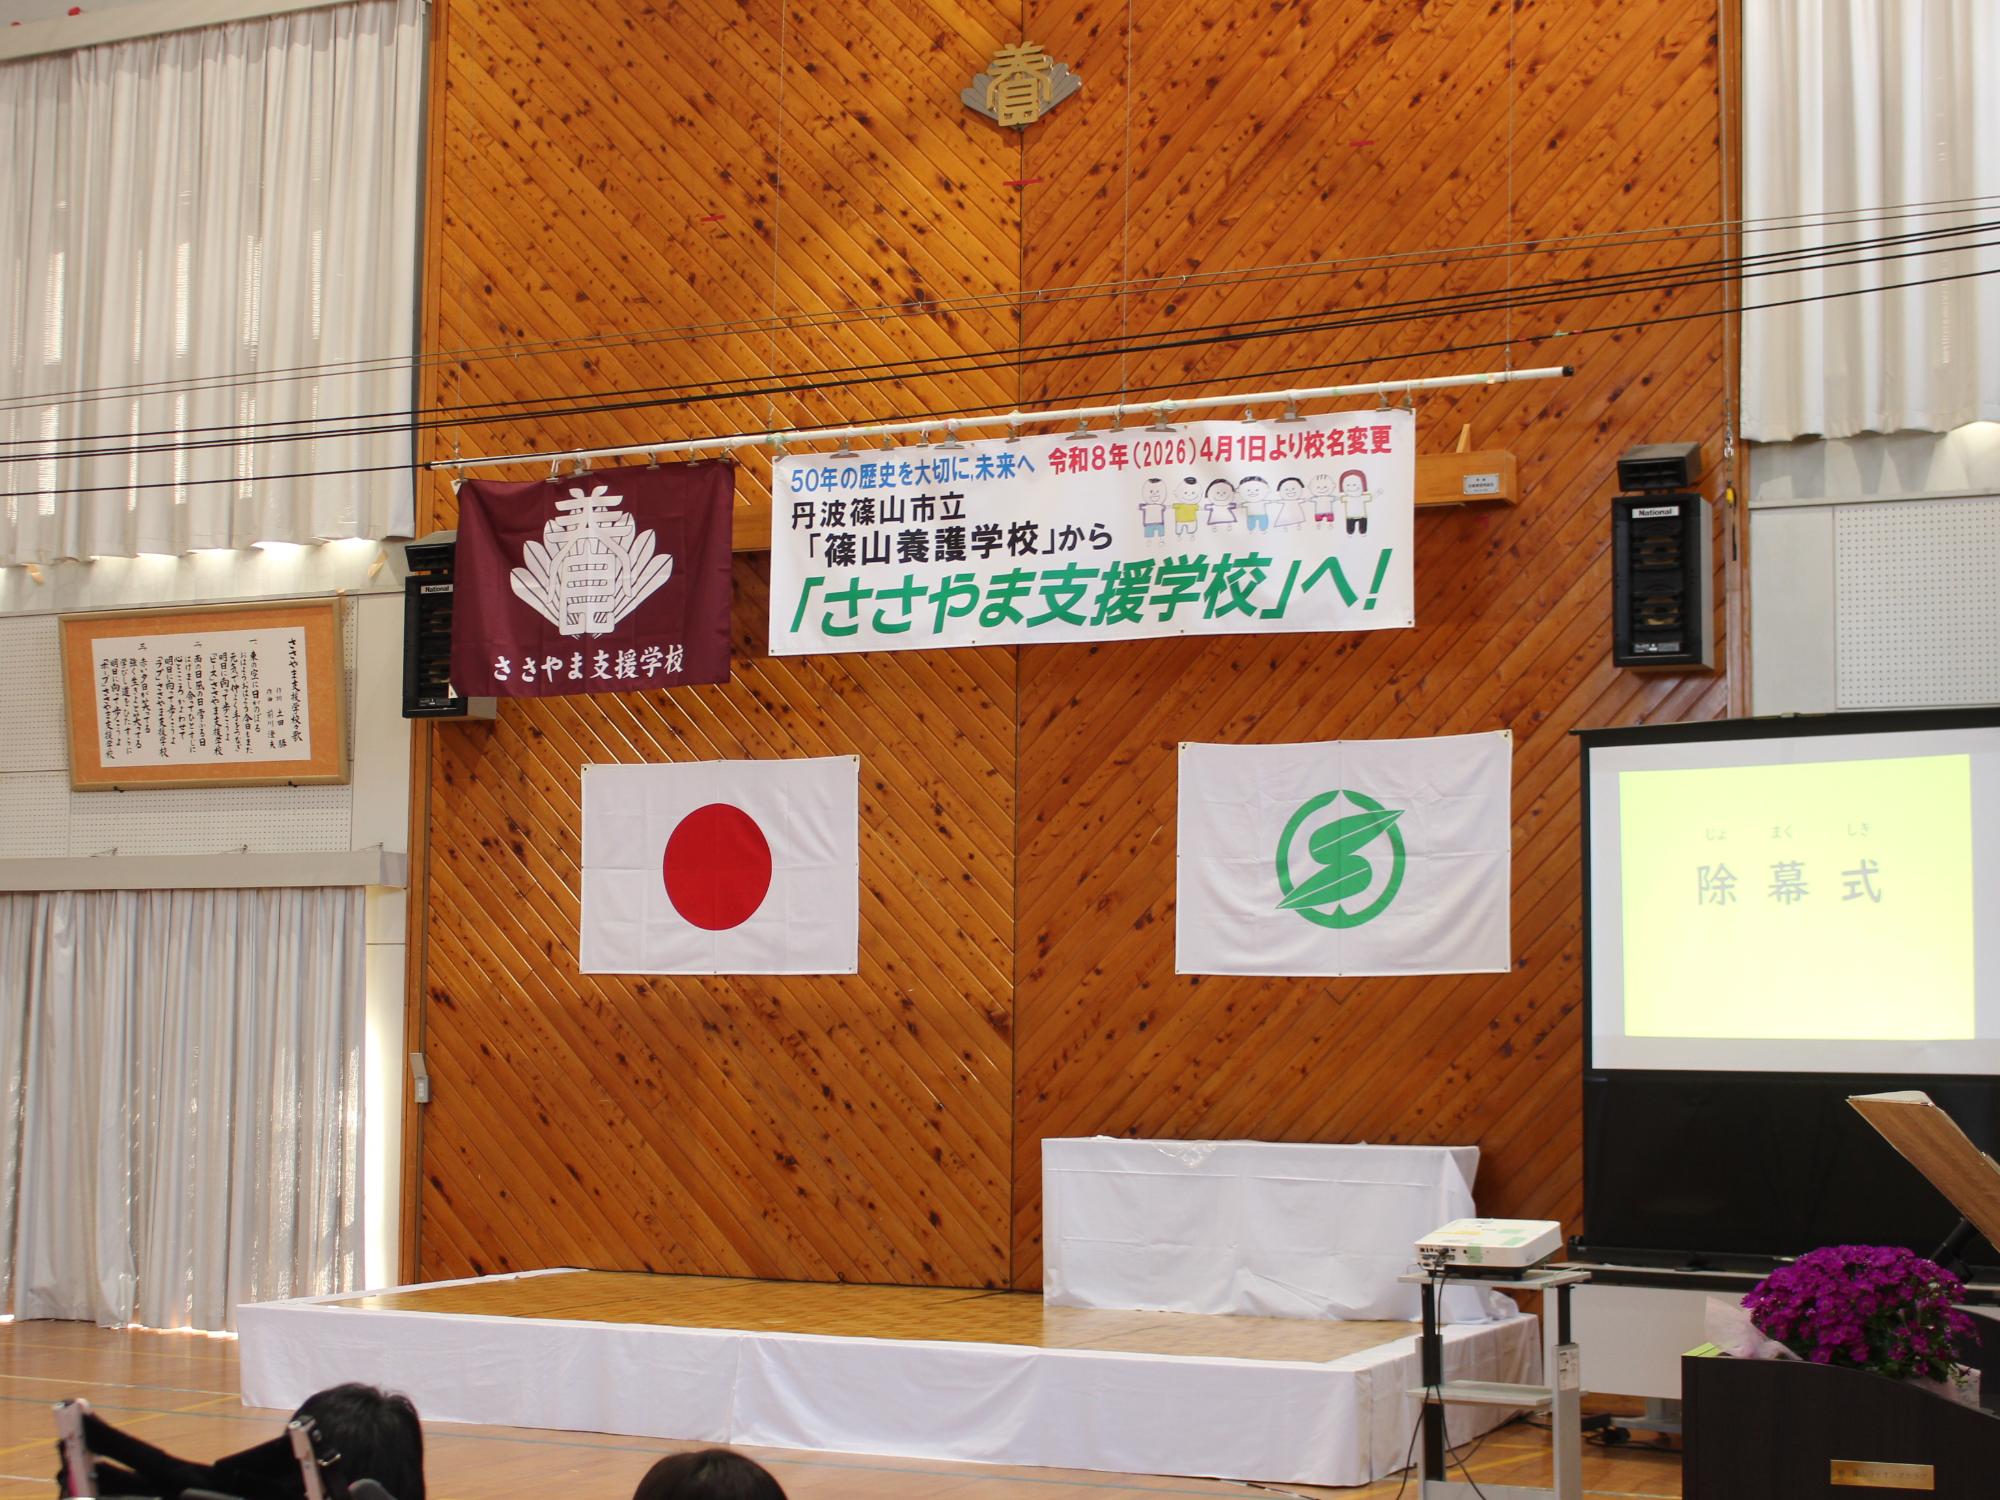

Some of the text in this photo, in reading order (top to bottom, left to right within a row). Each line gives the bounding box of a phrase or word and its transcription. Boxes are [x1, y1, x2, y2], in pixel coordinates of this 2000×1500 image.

[791, 491, 967, 530] 丹波篠山市立
[1638, 508, 1672, 517] National
[808, 521, 1113, 568] 「篠山養護学校」から
[425, 585, 449, 593] National
[790, 548, 1393, 637] 「ささやま支援学校」へ!
[493, 644, 684, 682] ささやま支援学校
